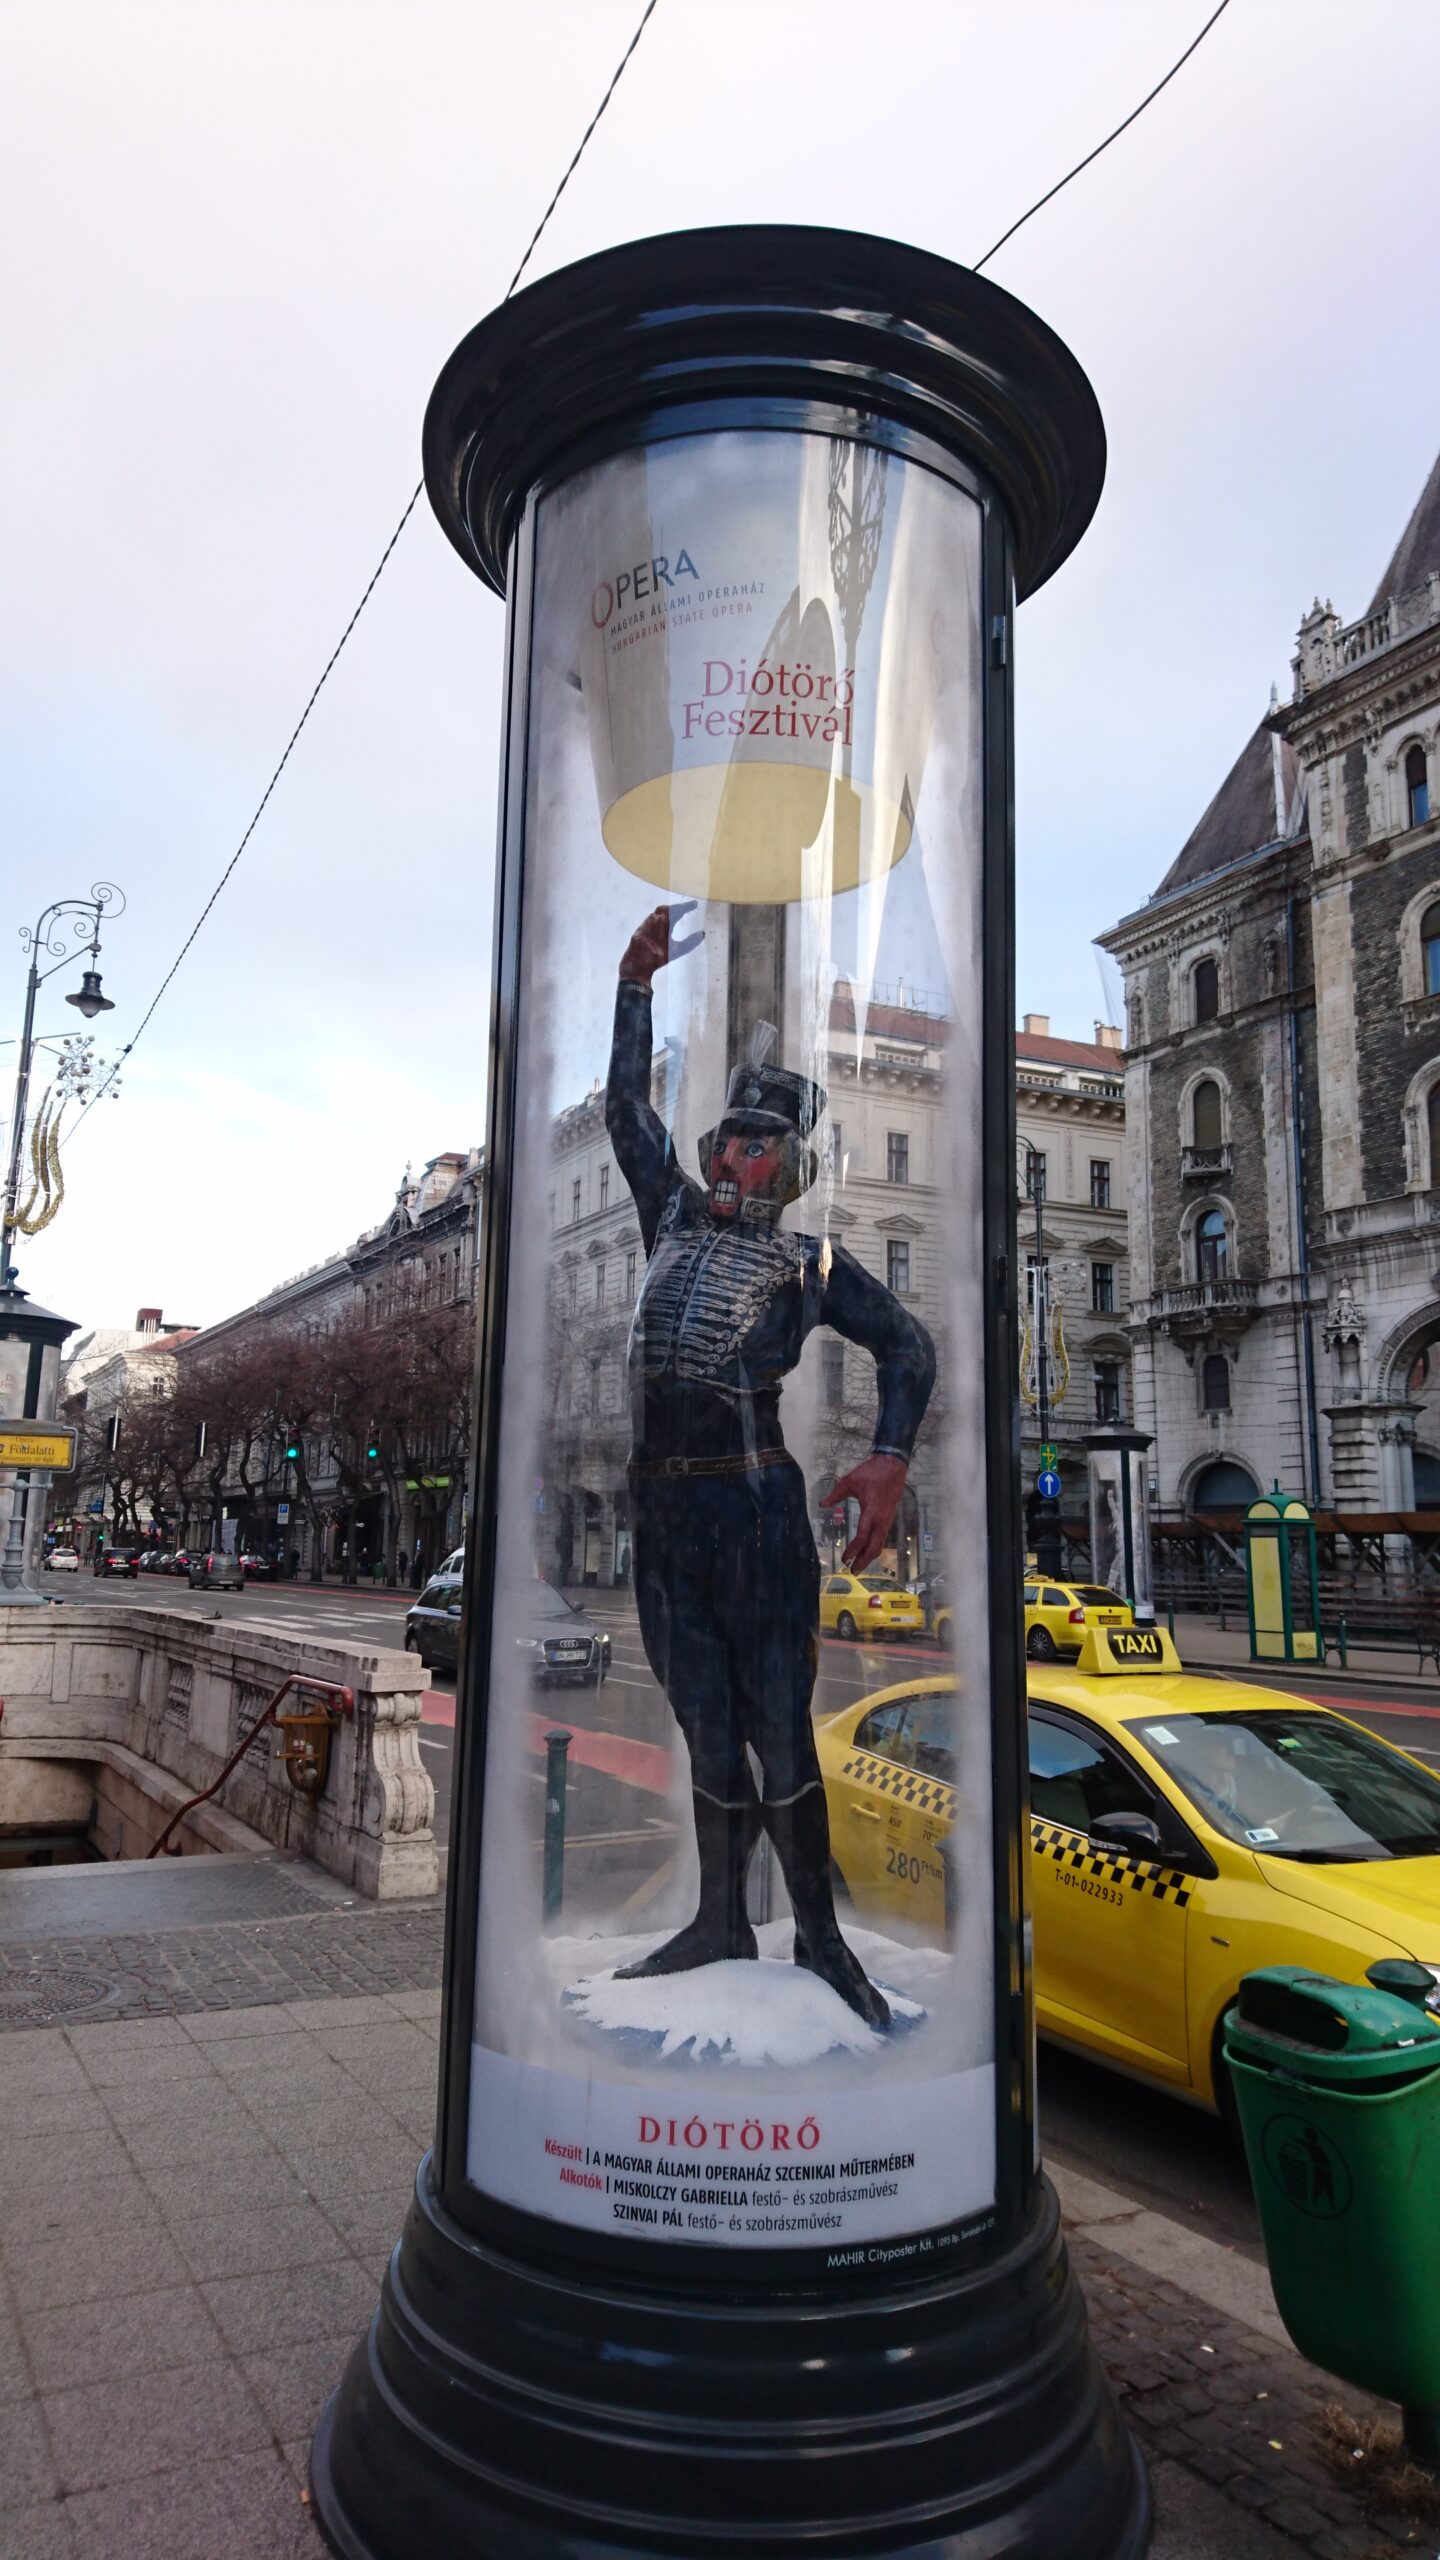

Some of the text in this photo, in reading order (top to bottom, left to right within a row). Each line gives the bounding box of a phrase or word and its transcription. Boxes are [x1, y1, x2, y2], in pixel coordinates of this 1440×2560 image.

[592, 549, 699, 629] OPERA
[610, 582, 766, 637] MAGYAR ÁLLAMI OPERAHÁZ
[611, 603, 753, 653] HUNGARIAN STATE OPERA
[702, 657, 855, 706] Diótörő
[682, 699, 853, 746] Fesztivál
[1112, 1634, 1158, 1654] TAXI
[886, 1846, 921, 1884] 280
[1056, 1868, 1124, 1907] T-01-022933
[638, 2115, 821, 2151] DIÓTÖRŐ
[544, 2138, 583, 2162] Készült
[593, 2150, 601, 2167] A
[604, 2152, 652, 2174] MAGYAR
[656, 2156, 701, 2180] ÁLLAMI
[705, 2163, 771, 2182] OPERAHÁZ
[775, 2164, 836, 2182] SZCENIKAI
[839, 2152, 915, 2179] MŰTERMÉBEN
[559, 2167, 603, 2191] Alkotók
[613, 2178, 677, 2201] MISKOLCZY
[681, 2187, 748, 2207] GABRIELLA
[752, 2191, 789, 2207] festő-
[793, 2189, 806, 2206] és
[809, 2181, 899, 2206] szobrászművész
[613, 2202, 843, 2231] SZINVAI PÁL festő- és szobrászművész
[827, 2250, 865, 2268] MAHIR
[868, 2244, 917, 2264] Cityposter
